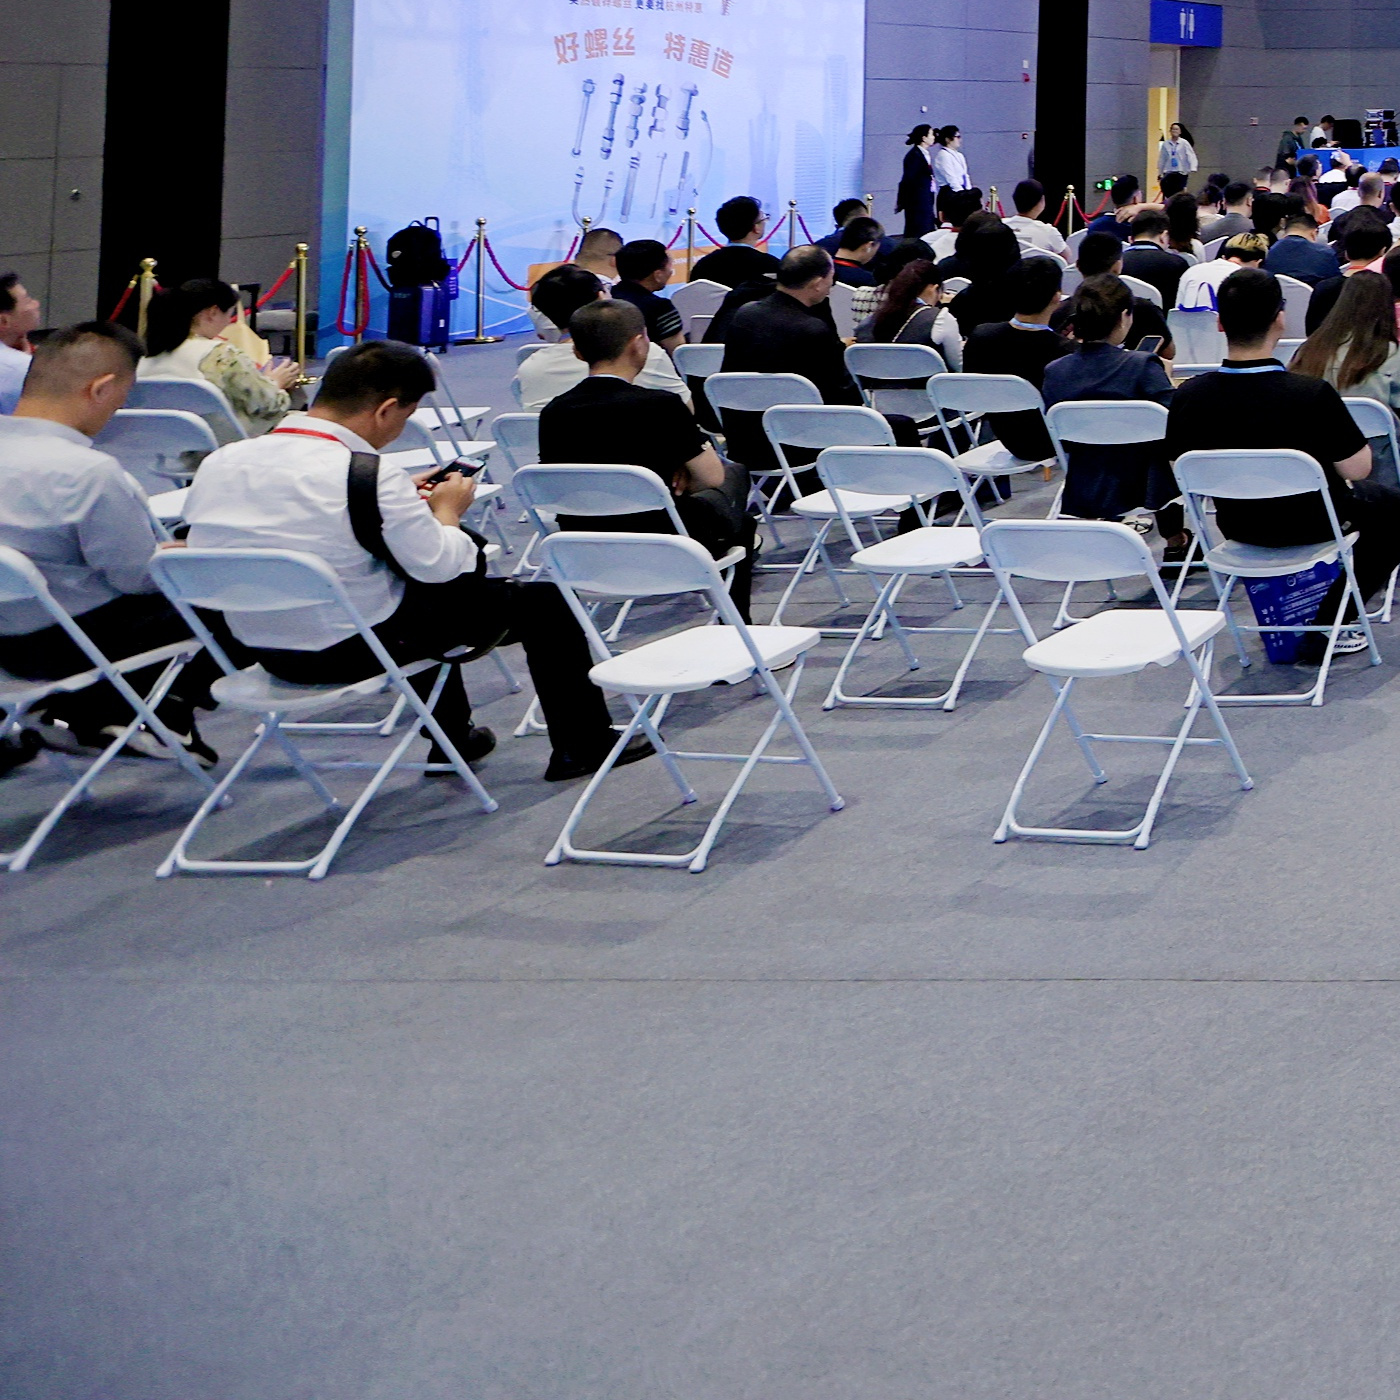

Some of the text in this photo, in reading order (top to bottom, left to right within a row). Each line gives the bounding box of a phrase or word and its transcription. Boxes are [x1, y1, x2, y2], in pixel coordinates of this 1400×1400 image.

[554, 27, 735, 79] 好螺丝 特惠造
